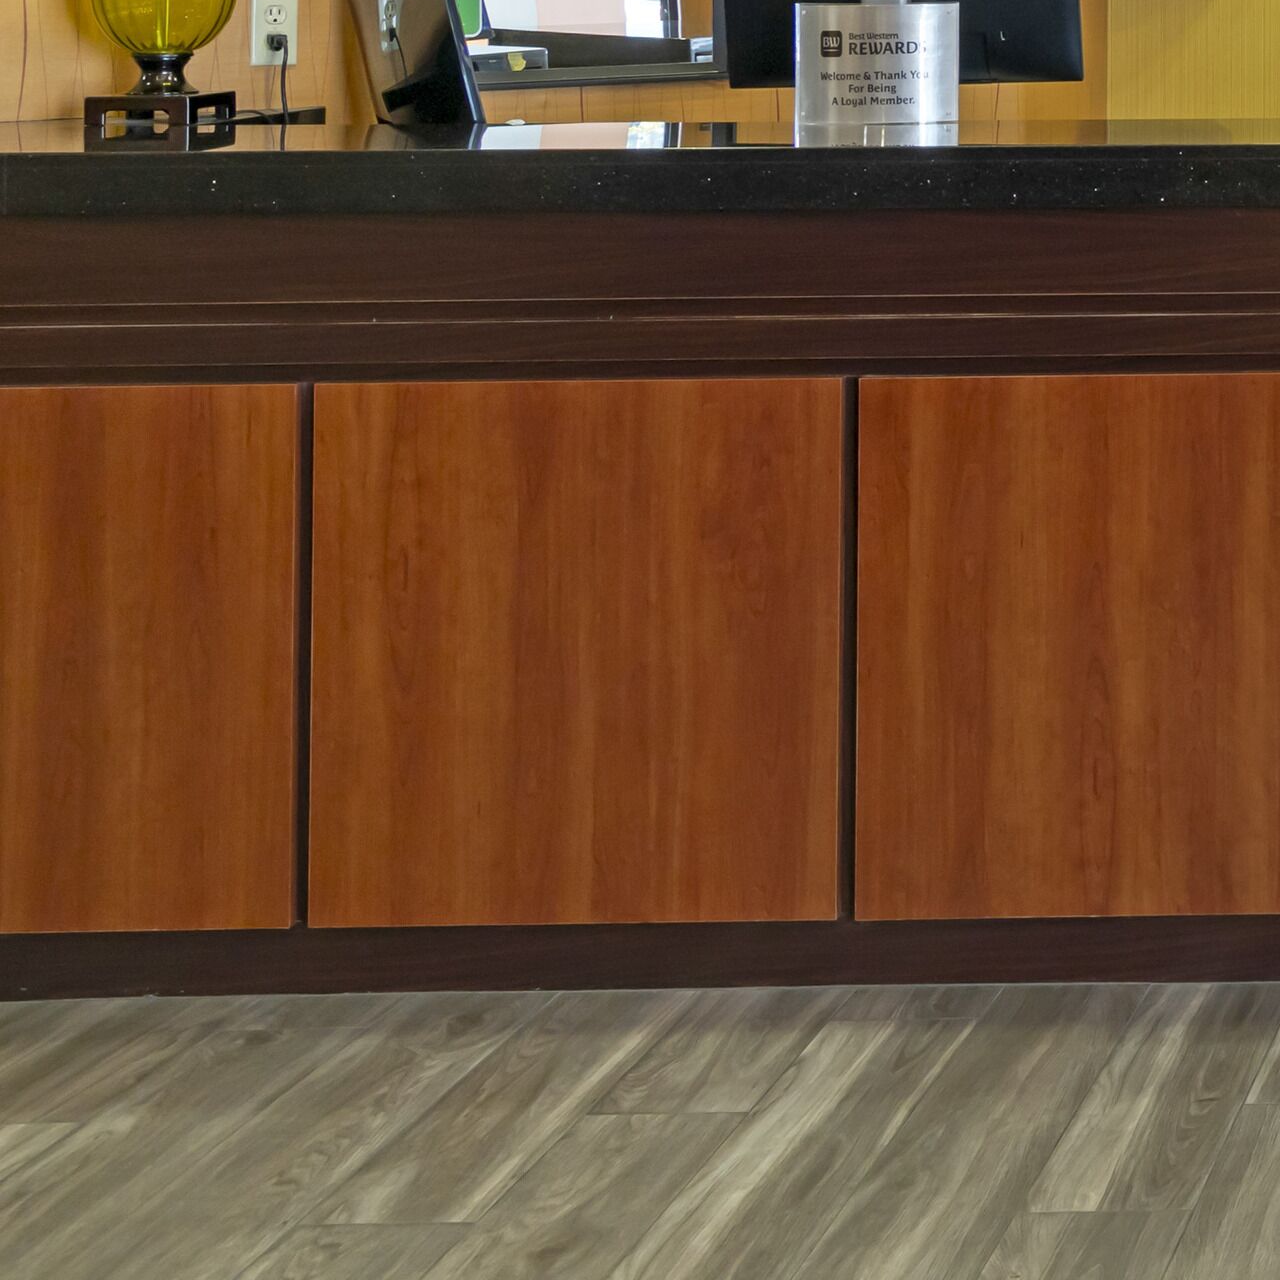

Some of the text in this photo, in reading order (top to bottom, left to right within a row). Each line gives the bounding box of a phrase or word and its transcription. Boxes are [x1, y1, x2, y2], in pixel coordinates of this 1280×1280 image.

[849, 32, 865, 40] Best
[823, 36, 840, 48] BW
[820, 72, 862, 81] Welcome
[864, 72, 871, 80] &
[874, 70, 907, 80] Thank
[848, 84, 897, 94] For Being
[832, 96, 916, 107] A Loyal Member.
